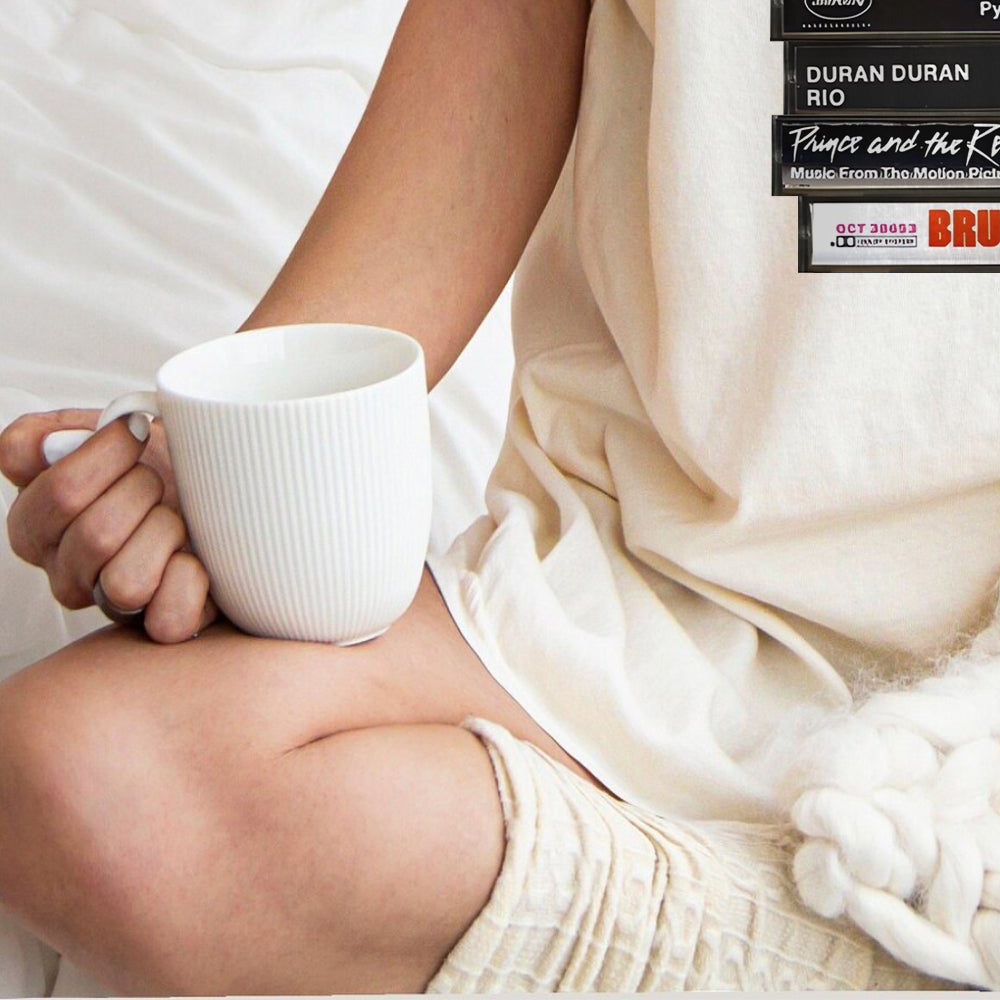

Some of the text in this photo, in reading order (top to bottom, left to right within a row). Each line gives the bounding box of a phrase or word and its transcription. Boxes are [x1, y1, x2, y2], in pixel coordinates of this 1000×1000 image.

[806, 64, 970, 83] DURAN DURAN
[807, 89, 845, 106] RIO
[788, 125, 863, 163] Prince
[866, 129, 920, 154] and
[924, 131, 963, 158] the
[790, 166, 835, 179] Music
[839, 167, 878, 179] From
[913, 167, 965, 179] Motion
[836, 223, 866, 233] OCT
